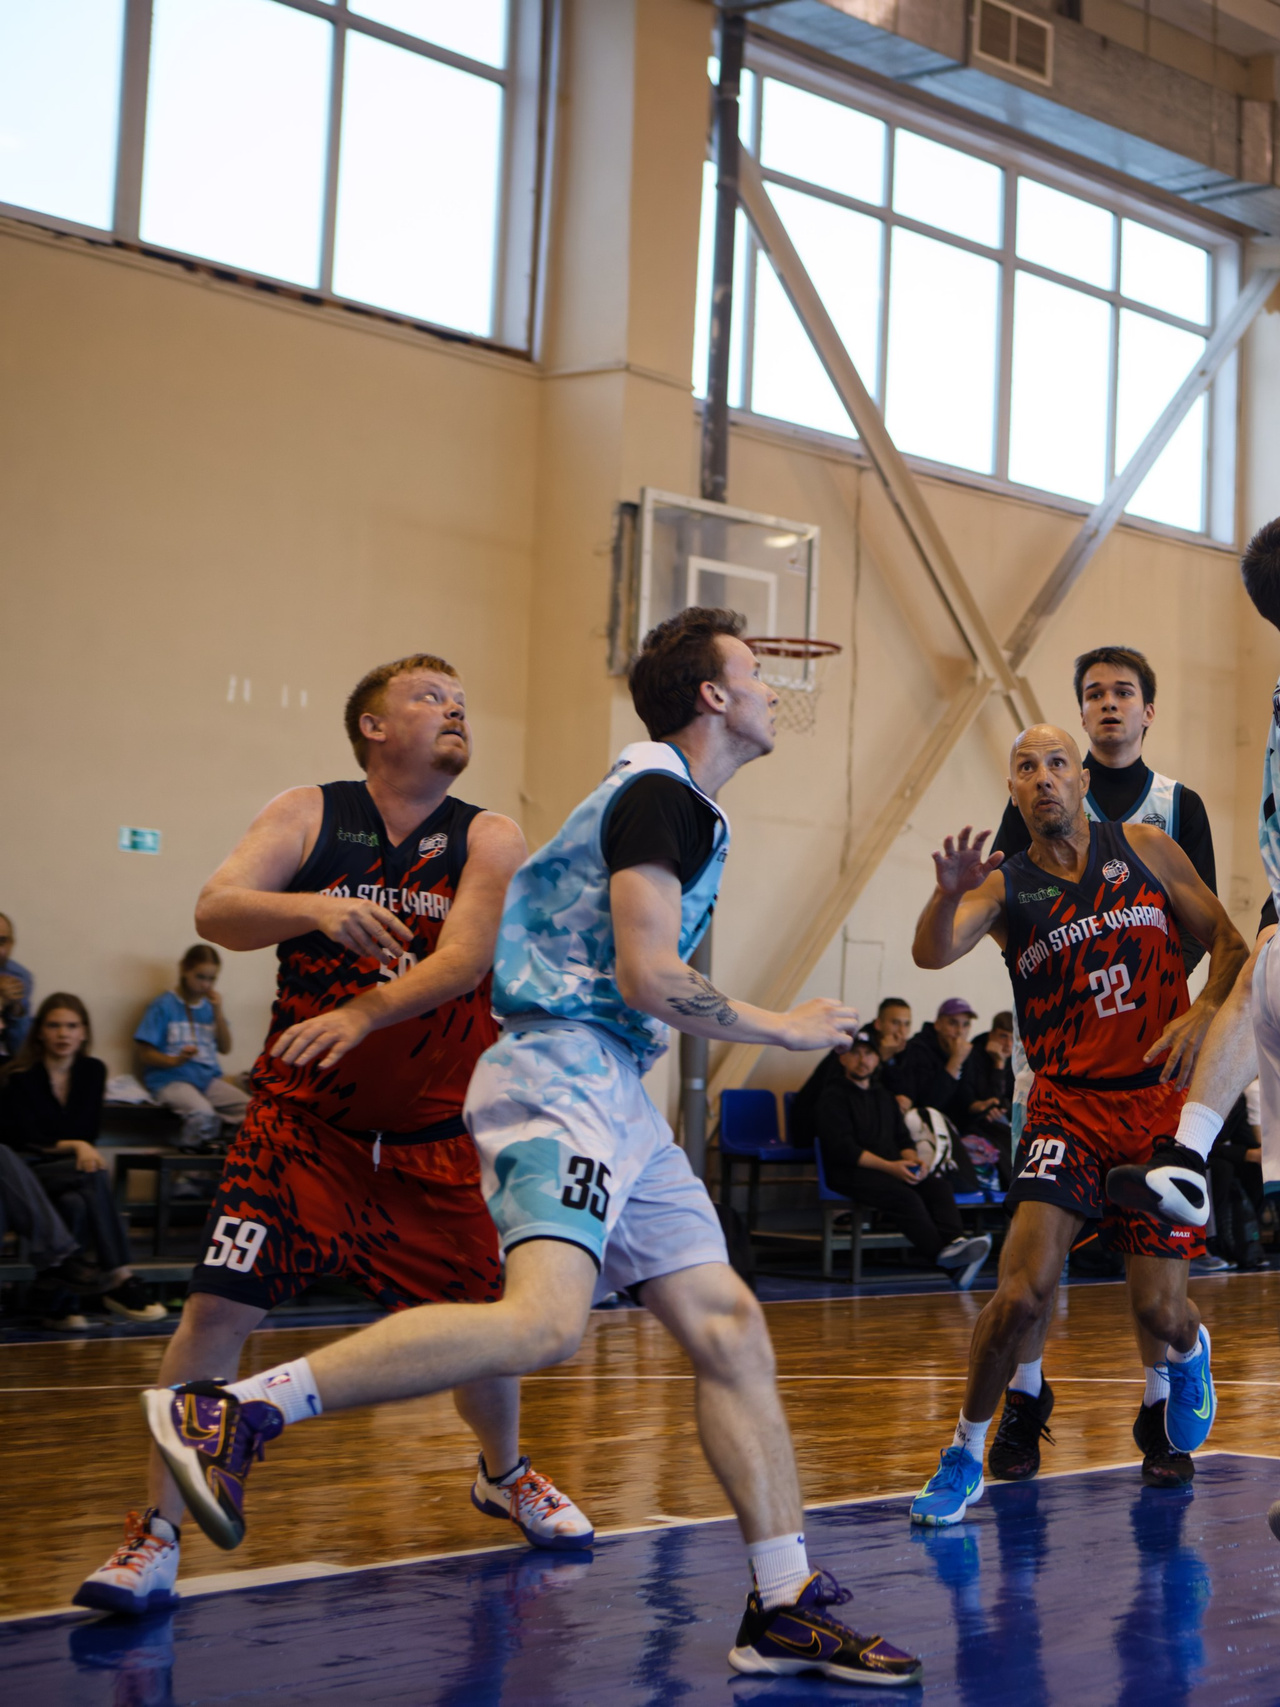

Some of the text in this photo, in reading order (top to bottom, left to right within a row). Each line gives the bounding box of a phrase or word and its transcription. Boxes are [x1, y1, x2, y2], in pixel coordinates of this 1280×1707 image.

[1018, 939, 1050, 980] PERM
[1048, 915, 1102, 952] STATE
[1088, 963, 1136, 1019] 22
[1018, 1138, 1066, 1181] 22
[561, 1155, 612, 1223] 35
[203, 1215, 267, 1273] 59
